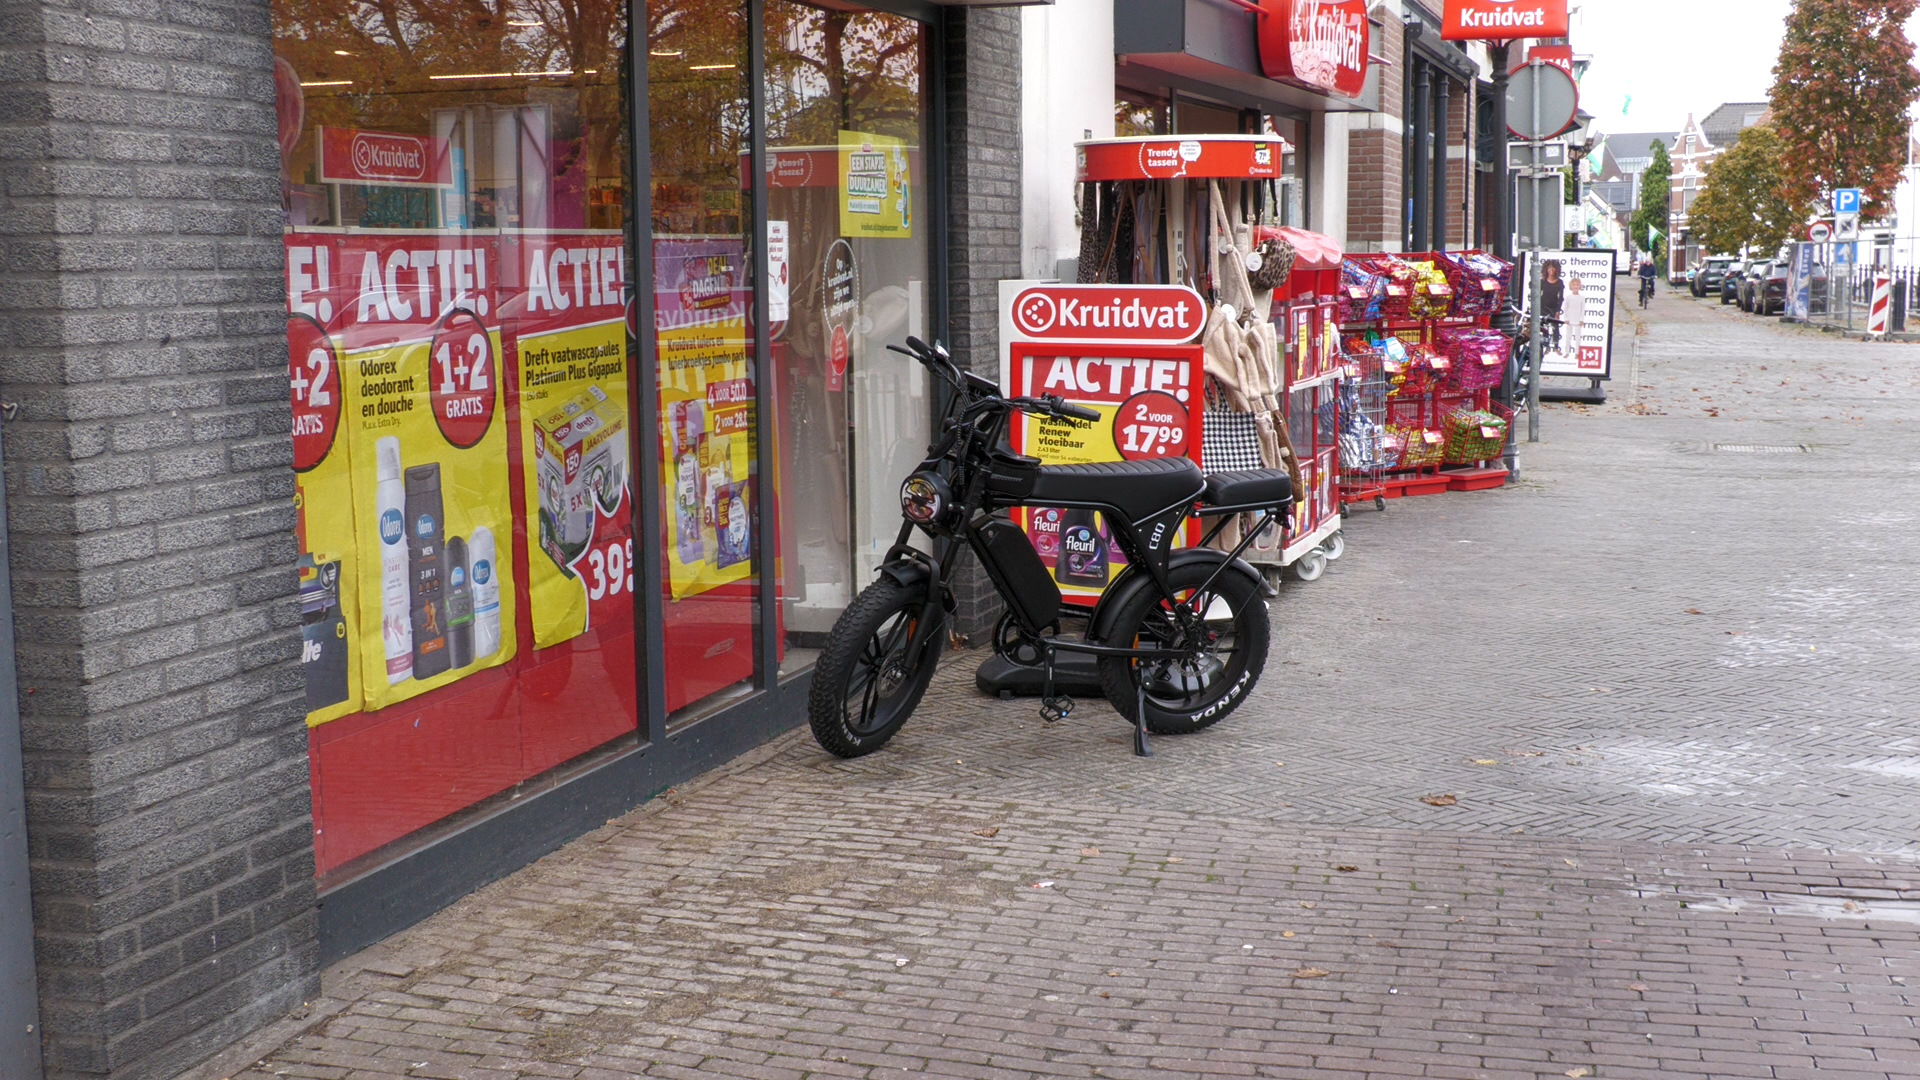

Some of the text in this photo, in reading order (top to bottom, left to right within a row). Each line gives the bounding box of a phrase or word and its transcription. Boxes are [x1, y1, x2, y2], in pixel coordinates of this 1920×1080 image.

[1461, 8, 1544, 26] Kruidvat
[1310, 0, 1362, 72] Kruidvat
[372, 147, 420, 170] Kruidvat
[852, 156, 884, 170] EEN STAPJE
[1147, 148, 1178, 158] Trendy
[850, 176, 886, 192] DUURZAMER
[1840, 192, 1853, 210] P
[1571, 258, 1608, 266] thermo
[527, 246, 625, 312] ACTIE!
[1570, 270, 1607, 278] thermo
[357, 249, 488, 322] ACTIE!
[1060, 298, 1190, 328] Kruidvat
[668, 334, 724, 352] Kruidvat luiers en
[525, 341, 620, 367] Dreft vaatwascapsules
[668, 348, 744, 370] luierbroekjes jumbo pack
[1582, 349, 1599, 360] 1+1
[360, 359, 398, 377] Odorex
[435, 334, 488, 395] 1+2
[526, 358, 622, 387] Platinum Plus Gigapack
[290, 348, 330, 407] +2
[362, 376, 414, 398] deodorant
[1044, 356, 1190, 402] ACTIE!
[362, 395, 414, 418] en douche
[708, 386, 715, 408] 4
[716, 389, 730, 402] VOOR
[446, 396, 483, 419] GRATIS
[1135, 404, 1173, 424] 2 VOOR
[575, 416, 595, 430] dreft
[715, 414, 720, 434] 2
[721, 416, 734, 428] VOOR
[1040, 426, 1071, 438] Renew
[586, 420, 622, 451] JAARVOLUME
[1038, 436, 1084, 448] vloeibaar
[1122, 424, 1183, 456] 17.99
[566, 454, 580, 473] 150
[571, 492, 583, 512] 5X
[382, 515, 401, 538] Odorex
[418, 520, 432, 535] Odorex
[1066, 536, 1095, 552] fleuril
[420, 571, 426, 580] 3
[426, 570, 432, 578] IN
[1191, 670, 1250, 722] KENDA
